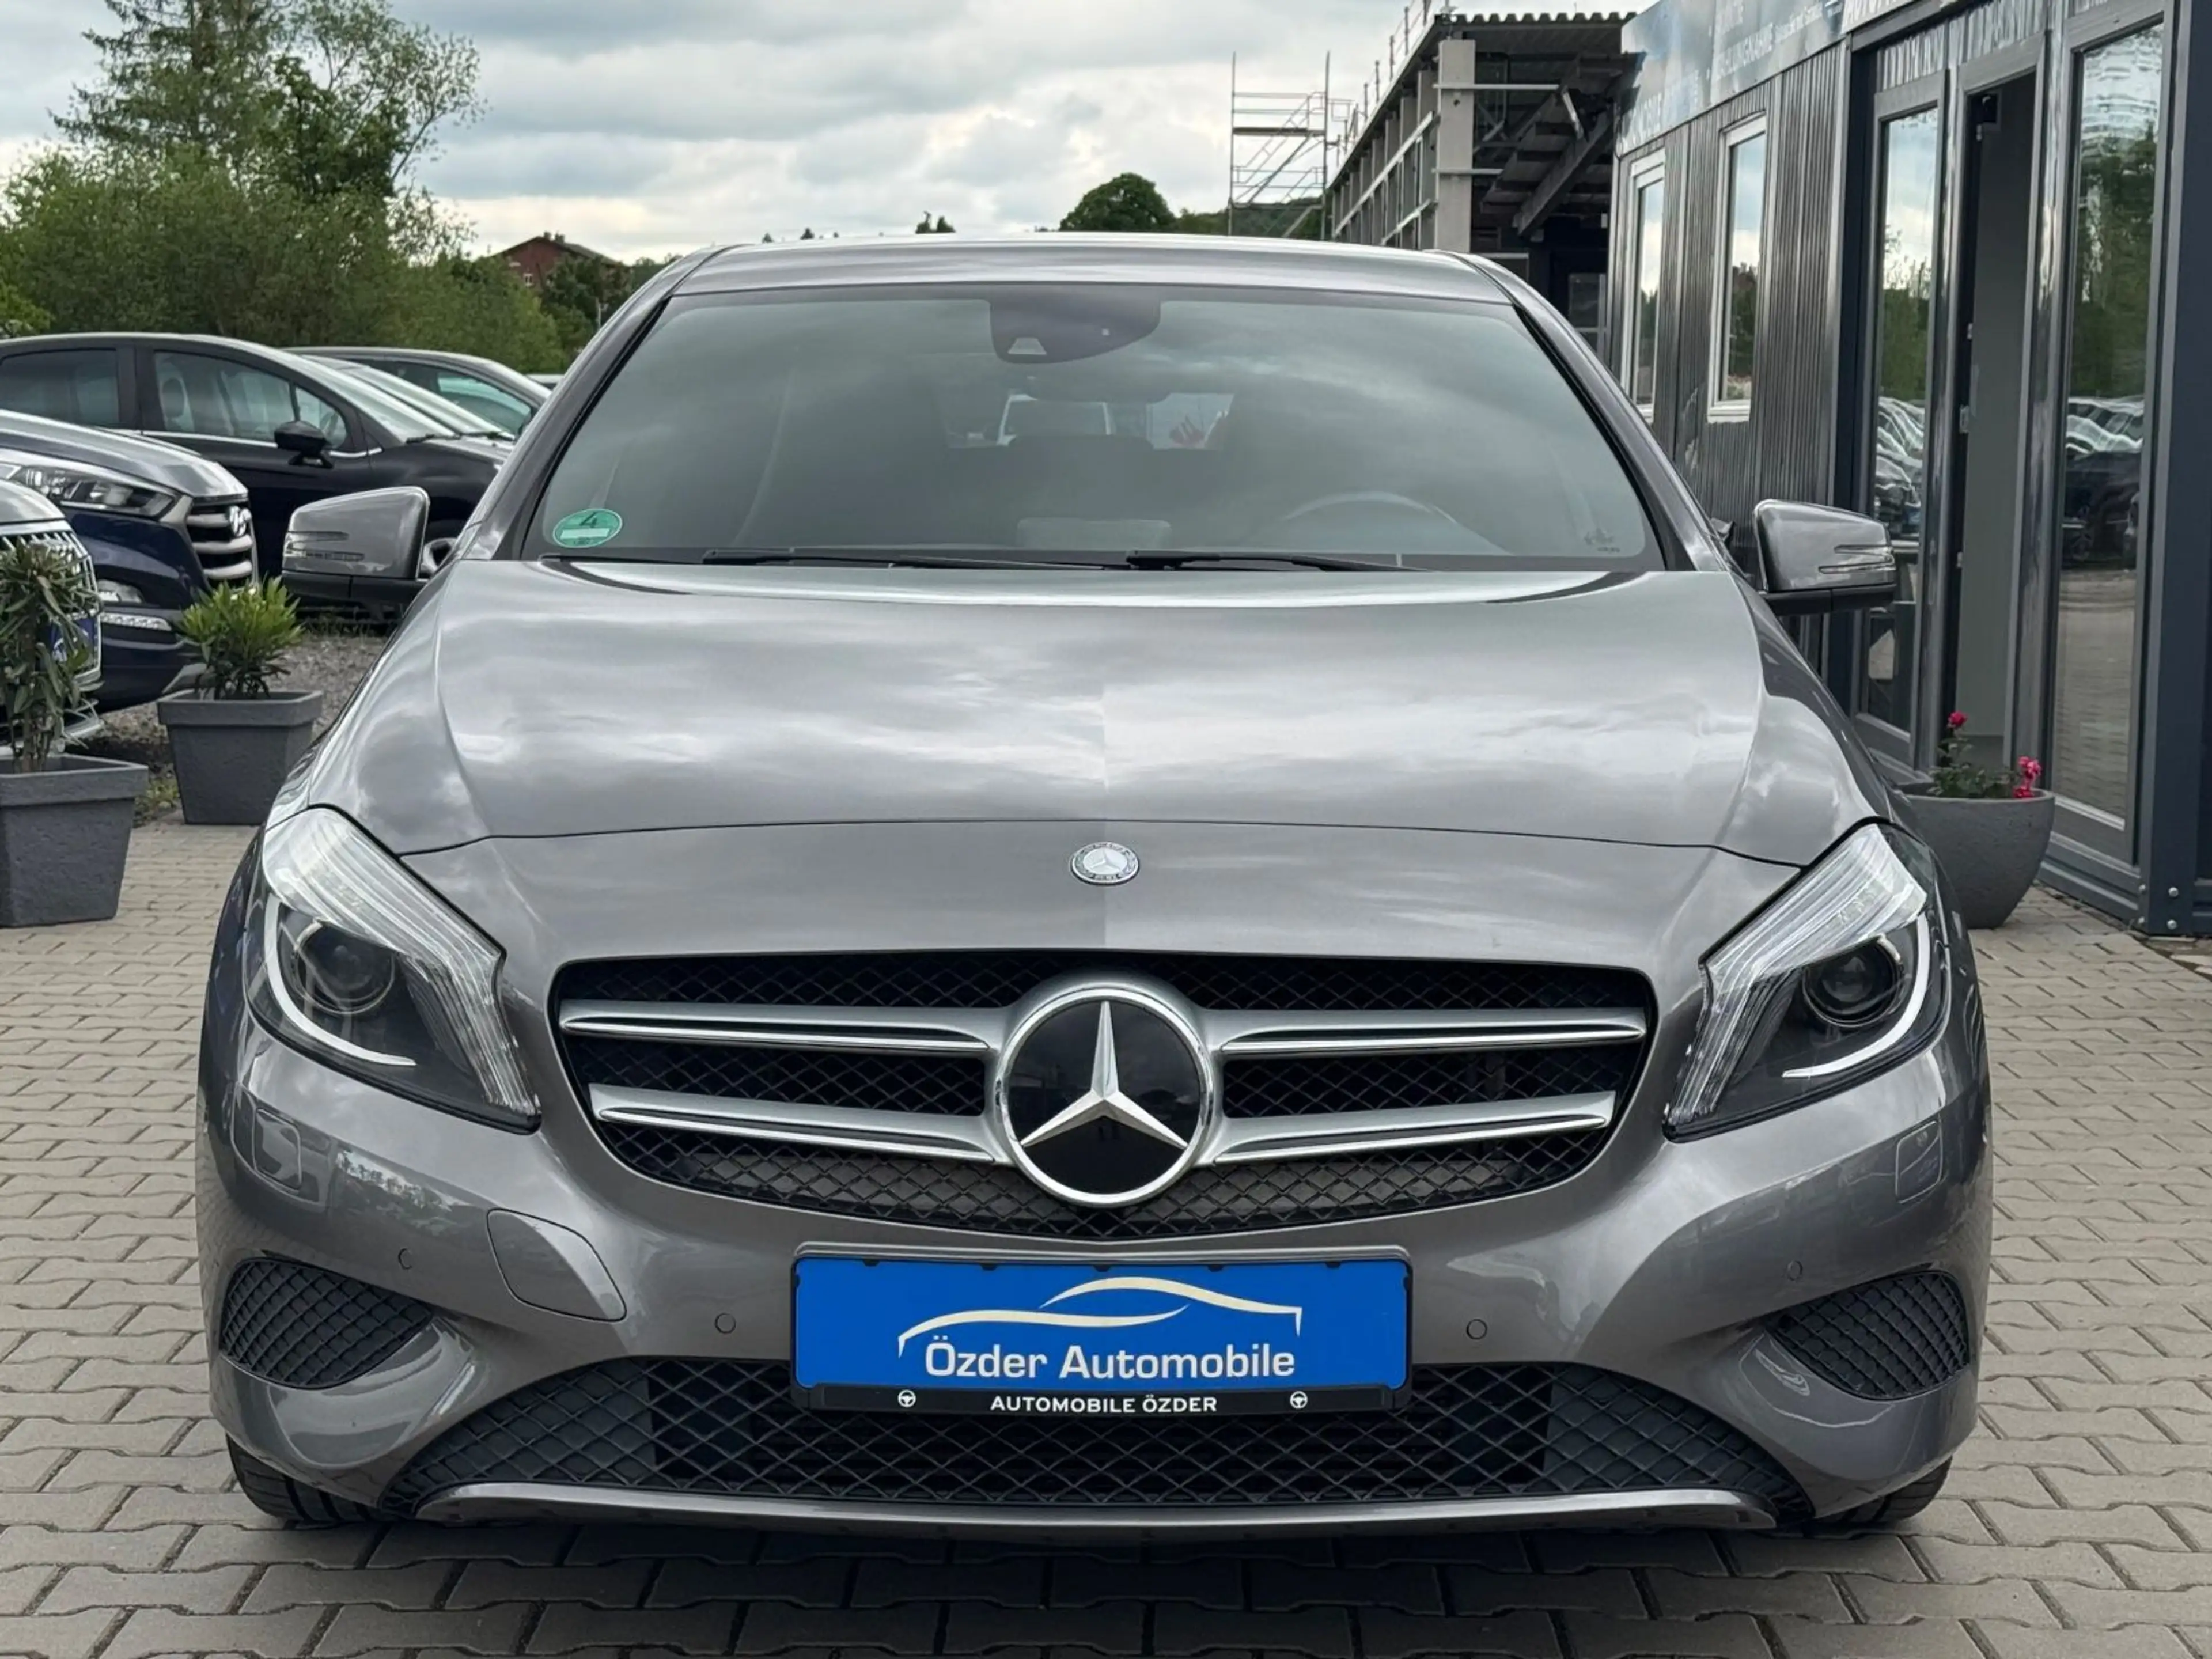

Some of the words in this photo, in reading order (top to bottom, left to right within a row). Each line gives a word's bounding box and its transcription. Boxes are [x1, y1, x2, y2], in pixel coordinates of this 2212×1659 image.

[579, 512, 597, 528] 4
[926, 1335, 1047, 1378] Özder
[1059, 1343, 1295, 1379] Automobile
[990, 1396, 1135, 1413] AUTOMOBILE
[1142, 1394, 1217, 1413] ÖZDER
